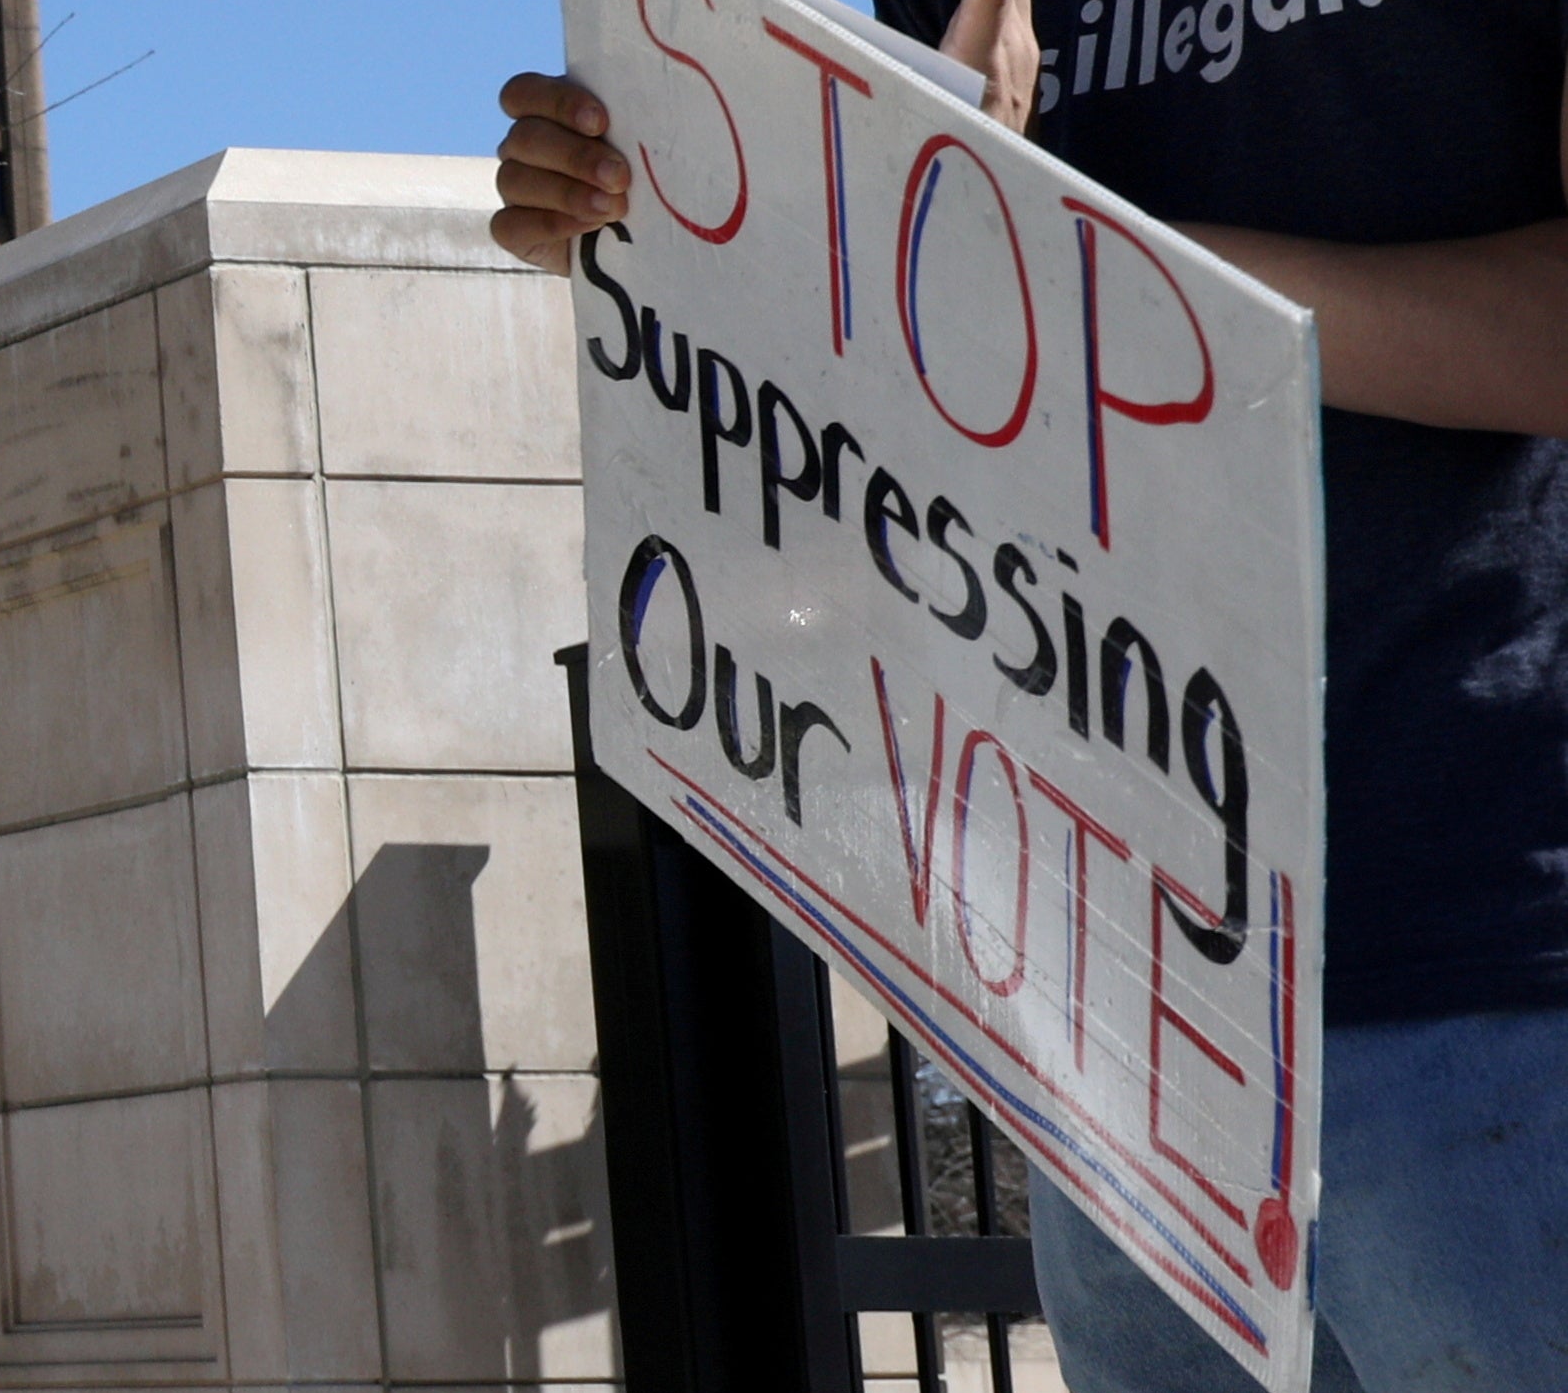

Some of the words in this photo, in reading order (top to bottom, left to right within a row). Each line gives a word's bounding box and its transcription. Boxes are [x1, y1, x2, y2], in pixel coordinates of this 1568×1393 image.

[1038, 47, 1061, 114] s
[578, 224, 1249, 964] Suppressing
[619, 534, 851, 826] Our
[870, 657, 1297, 1291] VOTE!
